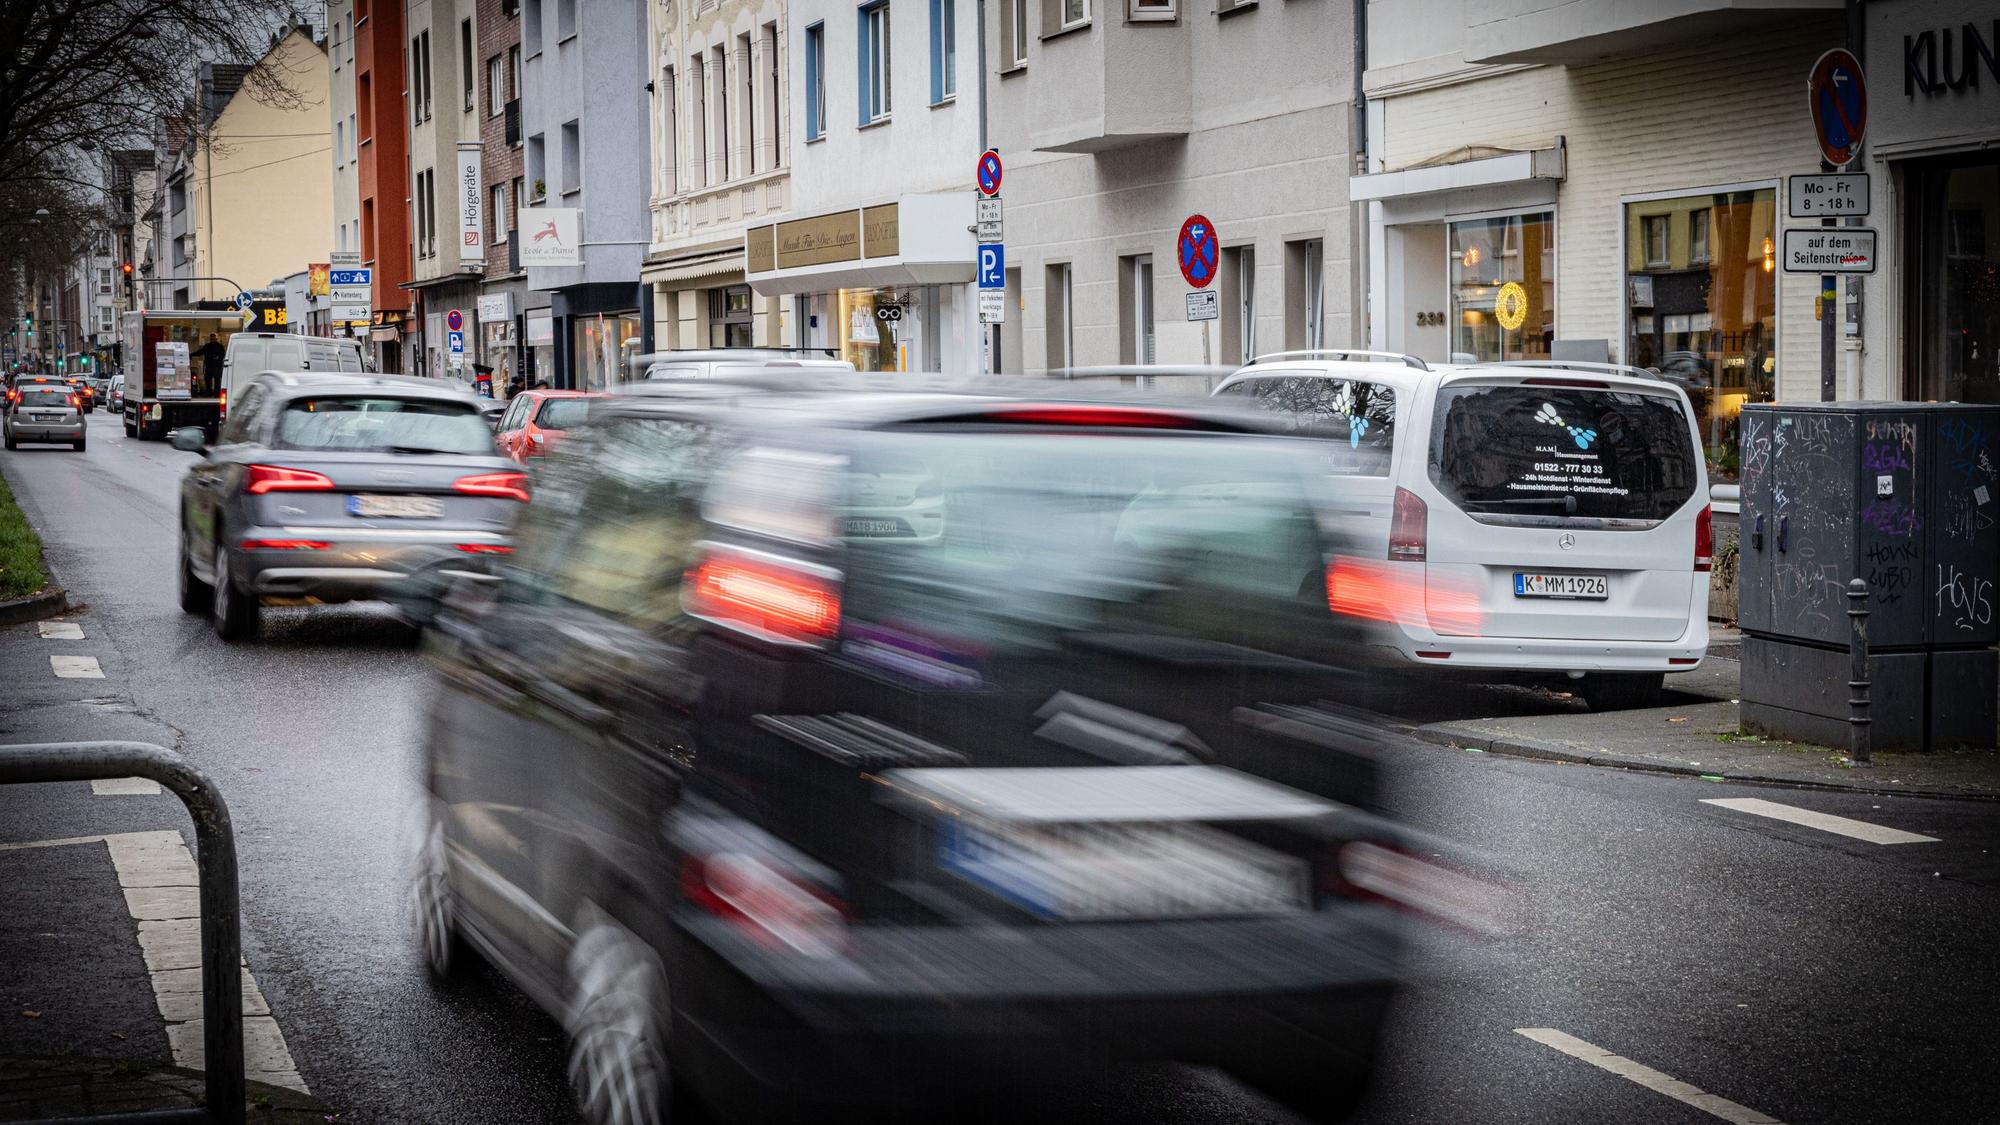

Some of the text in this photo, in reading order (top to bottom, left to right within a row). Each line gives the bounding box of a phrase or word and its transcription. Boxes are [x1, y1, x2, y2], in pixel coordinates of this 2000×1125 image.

[1804, 183, 1824, 194] Mo
[1837, 182, 1851, 193] Fr
[464, 165, 480, 226] Hörgeräte
[1803, 199, 1811, 209] 8
[1828, 198, 1842, 209] 18
[1847, 198, 1855, 208] h
[1808, 236, 1851, 248] auf dem
[982, 250, 996, 283] P
[1534, 462, 1559, 472] 01522
[1565, 464, 1580, 473] 777
[1581, 465, 1592, 473] 30
[1593, 465, 1603, 474] 33
[1573, 475, 1611, 484] Winterdienst
[1511, 482, 1569, 491] Hausmeisterdienst
[1574, 485, 1629, 496] Grünflächenpflege
[1525, 576, 1605, 594] K MM 1926
